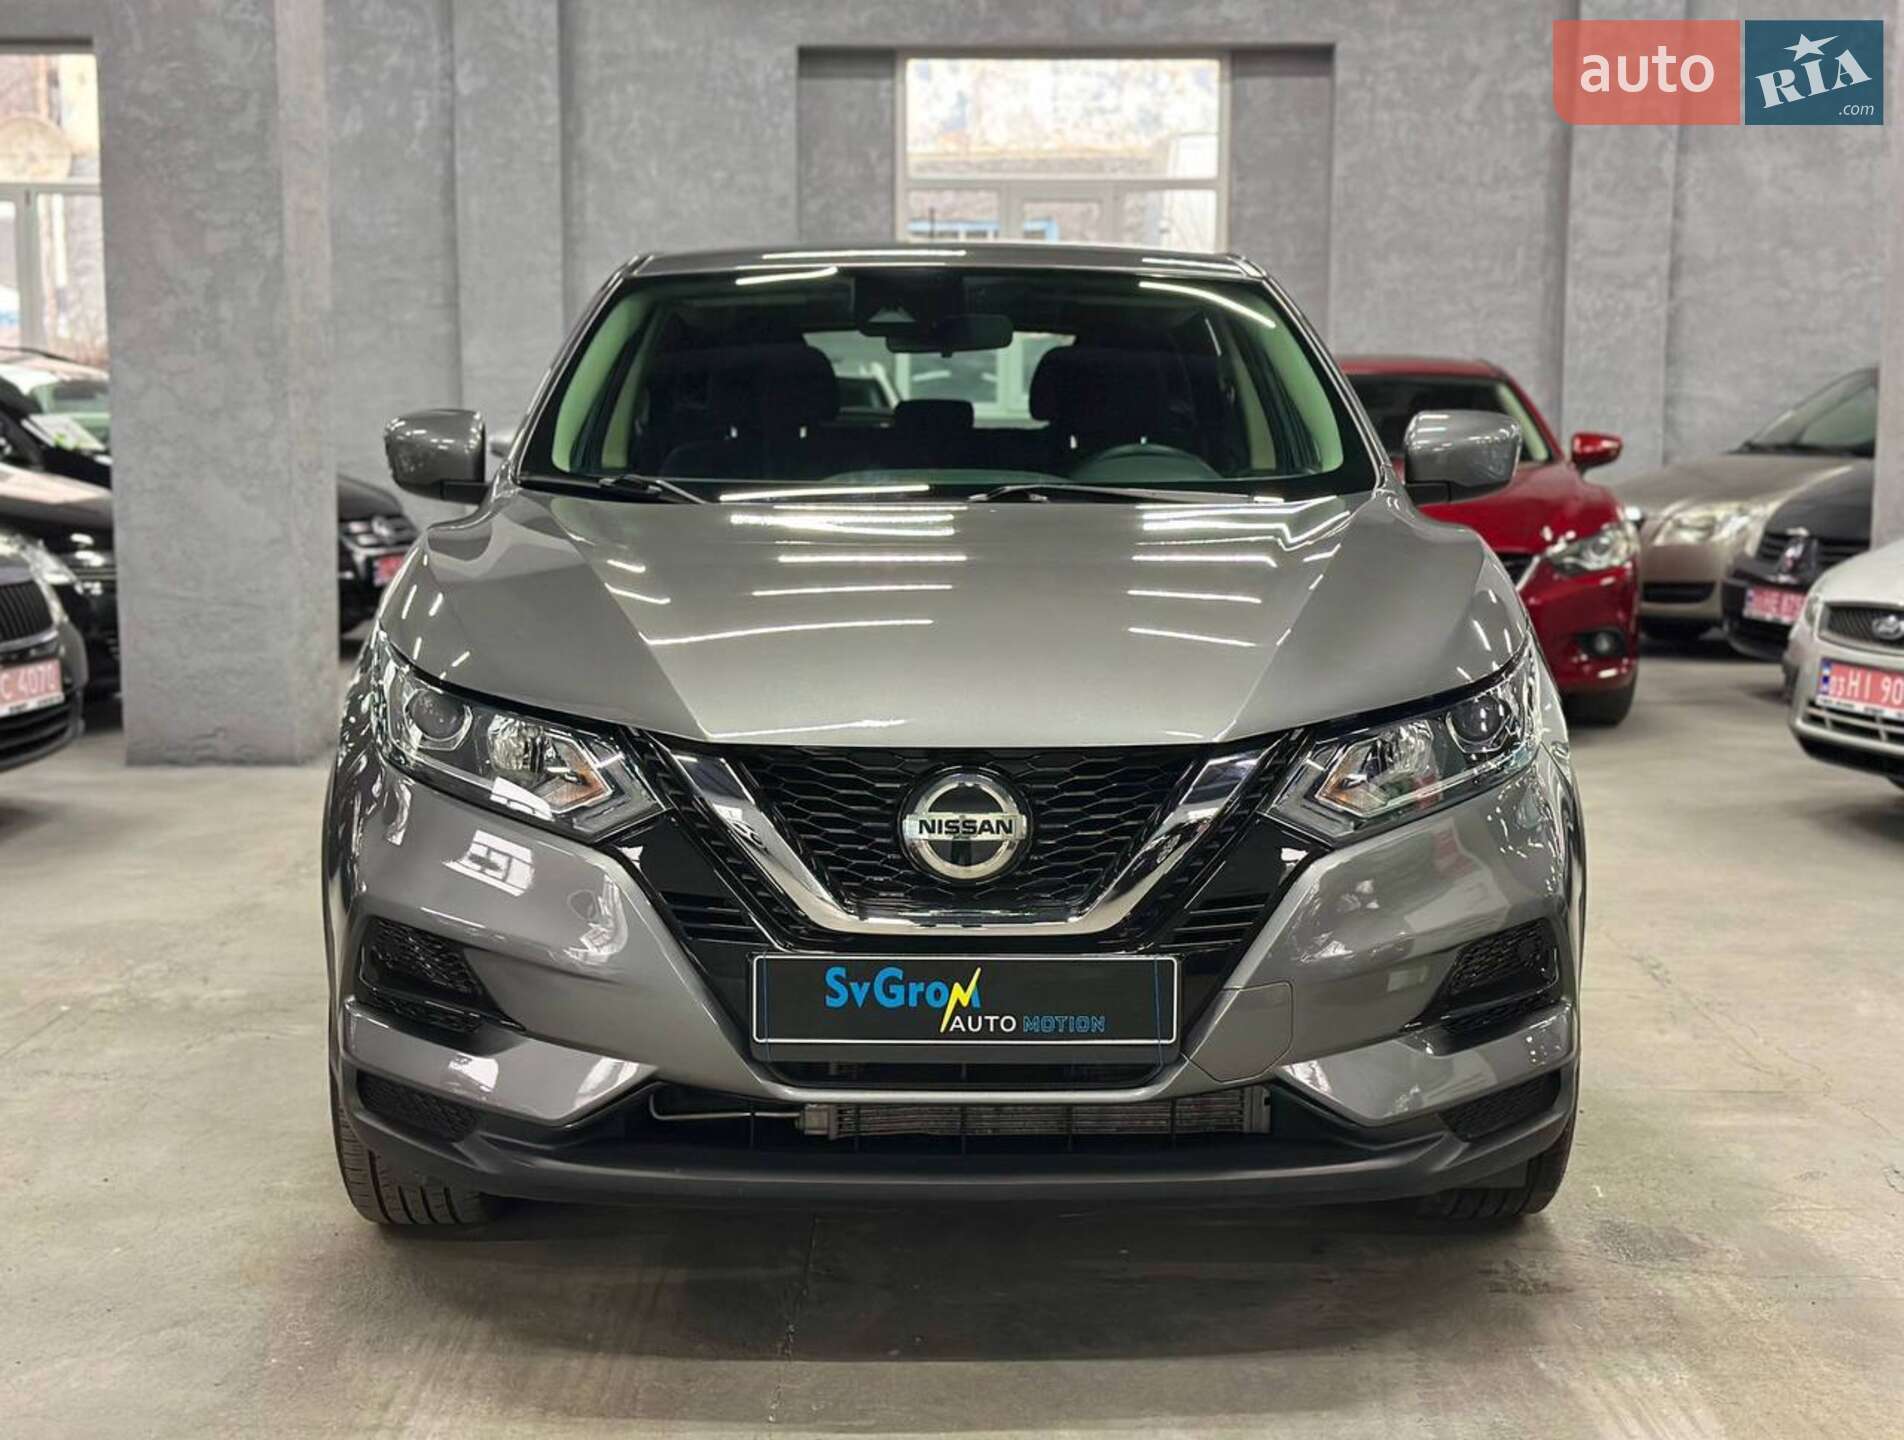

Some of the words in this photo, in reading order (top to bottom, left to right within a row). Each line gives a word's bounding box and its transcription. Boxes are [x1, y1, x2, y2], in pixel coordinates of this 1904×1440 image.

[918, 819, 1014, 836] NISSAN
[950, 1015, 1017, 1032] AUTO
[1023, 1015, 1107, 1033] MOTION
